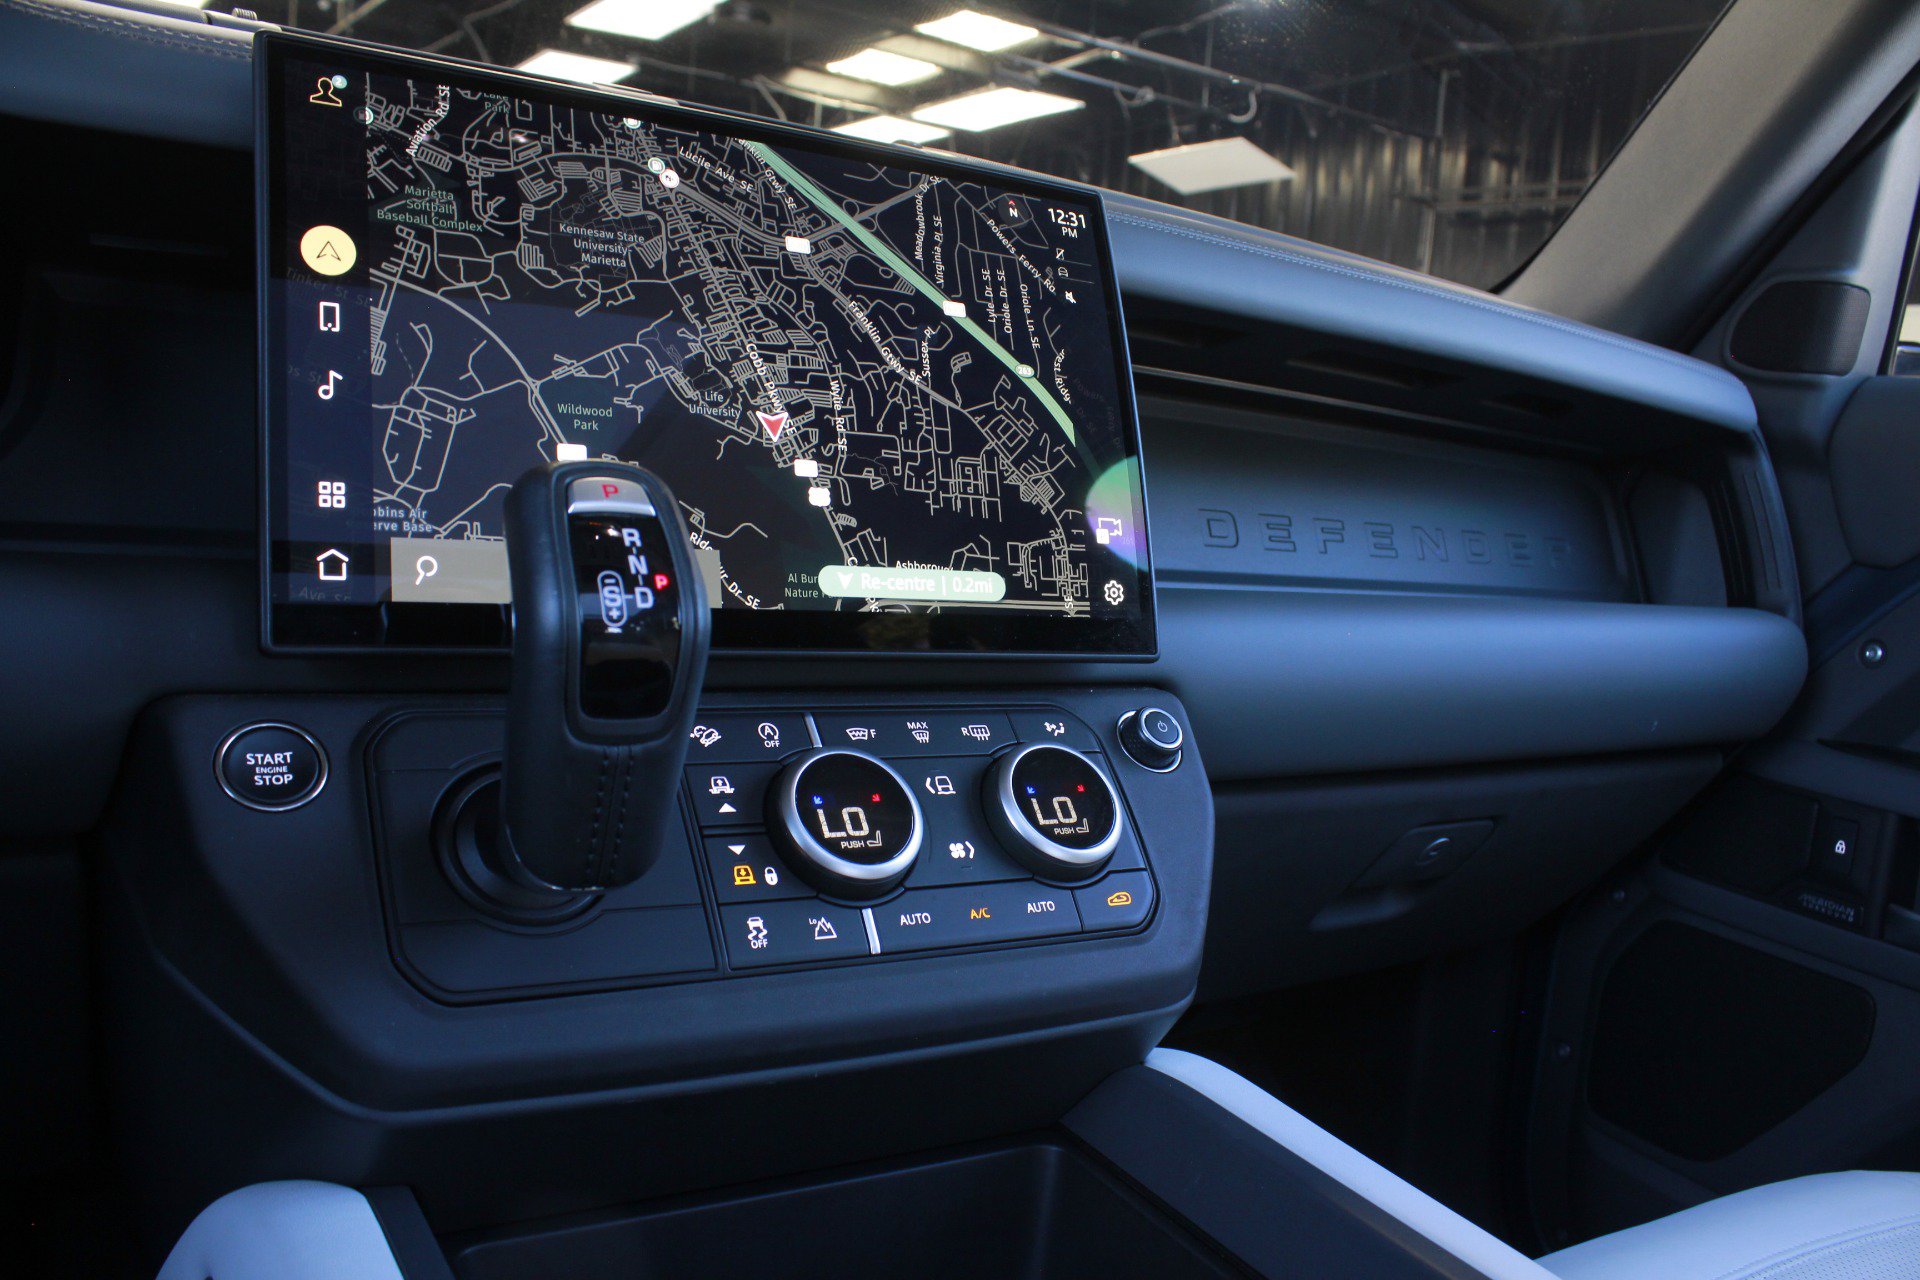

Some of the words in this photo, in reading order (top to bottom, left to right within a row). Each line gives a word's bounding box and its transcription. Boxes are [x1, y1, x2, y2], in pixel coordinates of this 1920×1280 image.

[484, 101, 510, 113] Park
[405, 118, 437, 157] Aviation
[435, 101, 450, 118] Rd
[679, 146, 711, 170] Lucile
[715, 166, 735, 184] Ave
[739, 180, 755, 193] SE
[404, 184, 454, 201] Marietta
[765, 169, 786, 194] Gtwy
[785, 196, 797, 210] SE
[919, 182, 930, 193] Dr
[406, 199, 454, 214] Softball
[1008, 207, 1019, 218] N
[377, 209, 430, 227] Baseball
[432, 216, 483, 232] Complex
[933, 214, 943, 227] SE
[1048, 207, 1086, 229] 12:31
[559, 222, 614, 240] Kennesaw
[617, 230, 645, 245] State
[914, 193, 926, 261] Meadowbrook
[1061, 226, 1078, 239] PM
[986, 219, 1017, 254] Powers
[1019, 254, 1042, 279] Ferry
[581, 252, 627, 268] Marietta
[932, 246, 945, 284] Virginia
[982, 268, 991, 281] SE
[996, 268, 1006, 281] SE
[984, 286, 994, 297] Dr
[999, 286, 1008, 297] Dr
[1019, 284, 1032, 314] Oriole
[986, 302, 997, 323] Lyle
[1002, 302, 1013, 334] Oriole
[923, 326, 936, 339] Pl
[1026, 319, 1035, 332] Ln
[848, 301, 882, 343] Franklin
[881, 346, 905, 374] Gtwy
[908, 371, 923, 386] SE
[1030, 336, 1040, 349] SE
[921, 340, 931, 377] Sussex
[746, 343, 767, 376] Cobb
[764, 381, 785, 414] Pkwy
[783, 419, 797, 436] SE
[829, 380, 844, 411] Wylie
[704, 391, 724, 403] Life
[557, 402, 613, 418] Wildwood
[689, 403, 741, 419] University
[573, 419, 599, 431] Park
[836, 417, 847, 432] Rd
[837, 437, 848, 452] SE
[602, 484, 619, 499] P
[409, 508, 427, 519] Air
[403, 521, 433, 532] Base
[621, 527, 642, 547] R
[1197, 507, 1572, 569] DEFENDER
[627, 554, 649, 575] N
[653, 574, 670, 590] P
[787, 574, 798, 583] Al
[861, 573, 936, 591] Re-centre
[952, 576, 993, 594] 0.2mi
[602, 585, 622, 608] S
[634, 586, 654, 608] D
[728, 581, 743, 597] Dr
[744, 594, 761, 610] SE
[784, 587, 819, 598] Nature
[1063, 595, 1074, 609] SE
[907, 721, 929, 730] MAX
[961, 727, 968, 736] R
[870, 729, 877, 738] F
[764, 740, 780, 748] OFF
[246, 752, 293, 765] START
[255, 765, 288, 774] ENGINE
[254, 774, 293, 786] STOP
[1031, 796, 1078, 825] LO
[816, 806, 870, 840] LO
[1054, 827, 1075, 836] PUSH
[840, 840, 865, 849] PUSH
[970, 907, 991, 919] A/C
[1027, 901, 1056, 914] AUTO
[809, 918, 817, 926] Lo
[900, 912, 931, 926] AUTO
[751, 939, 768, 949] OFF
